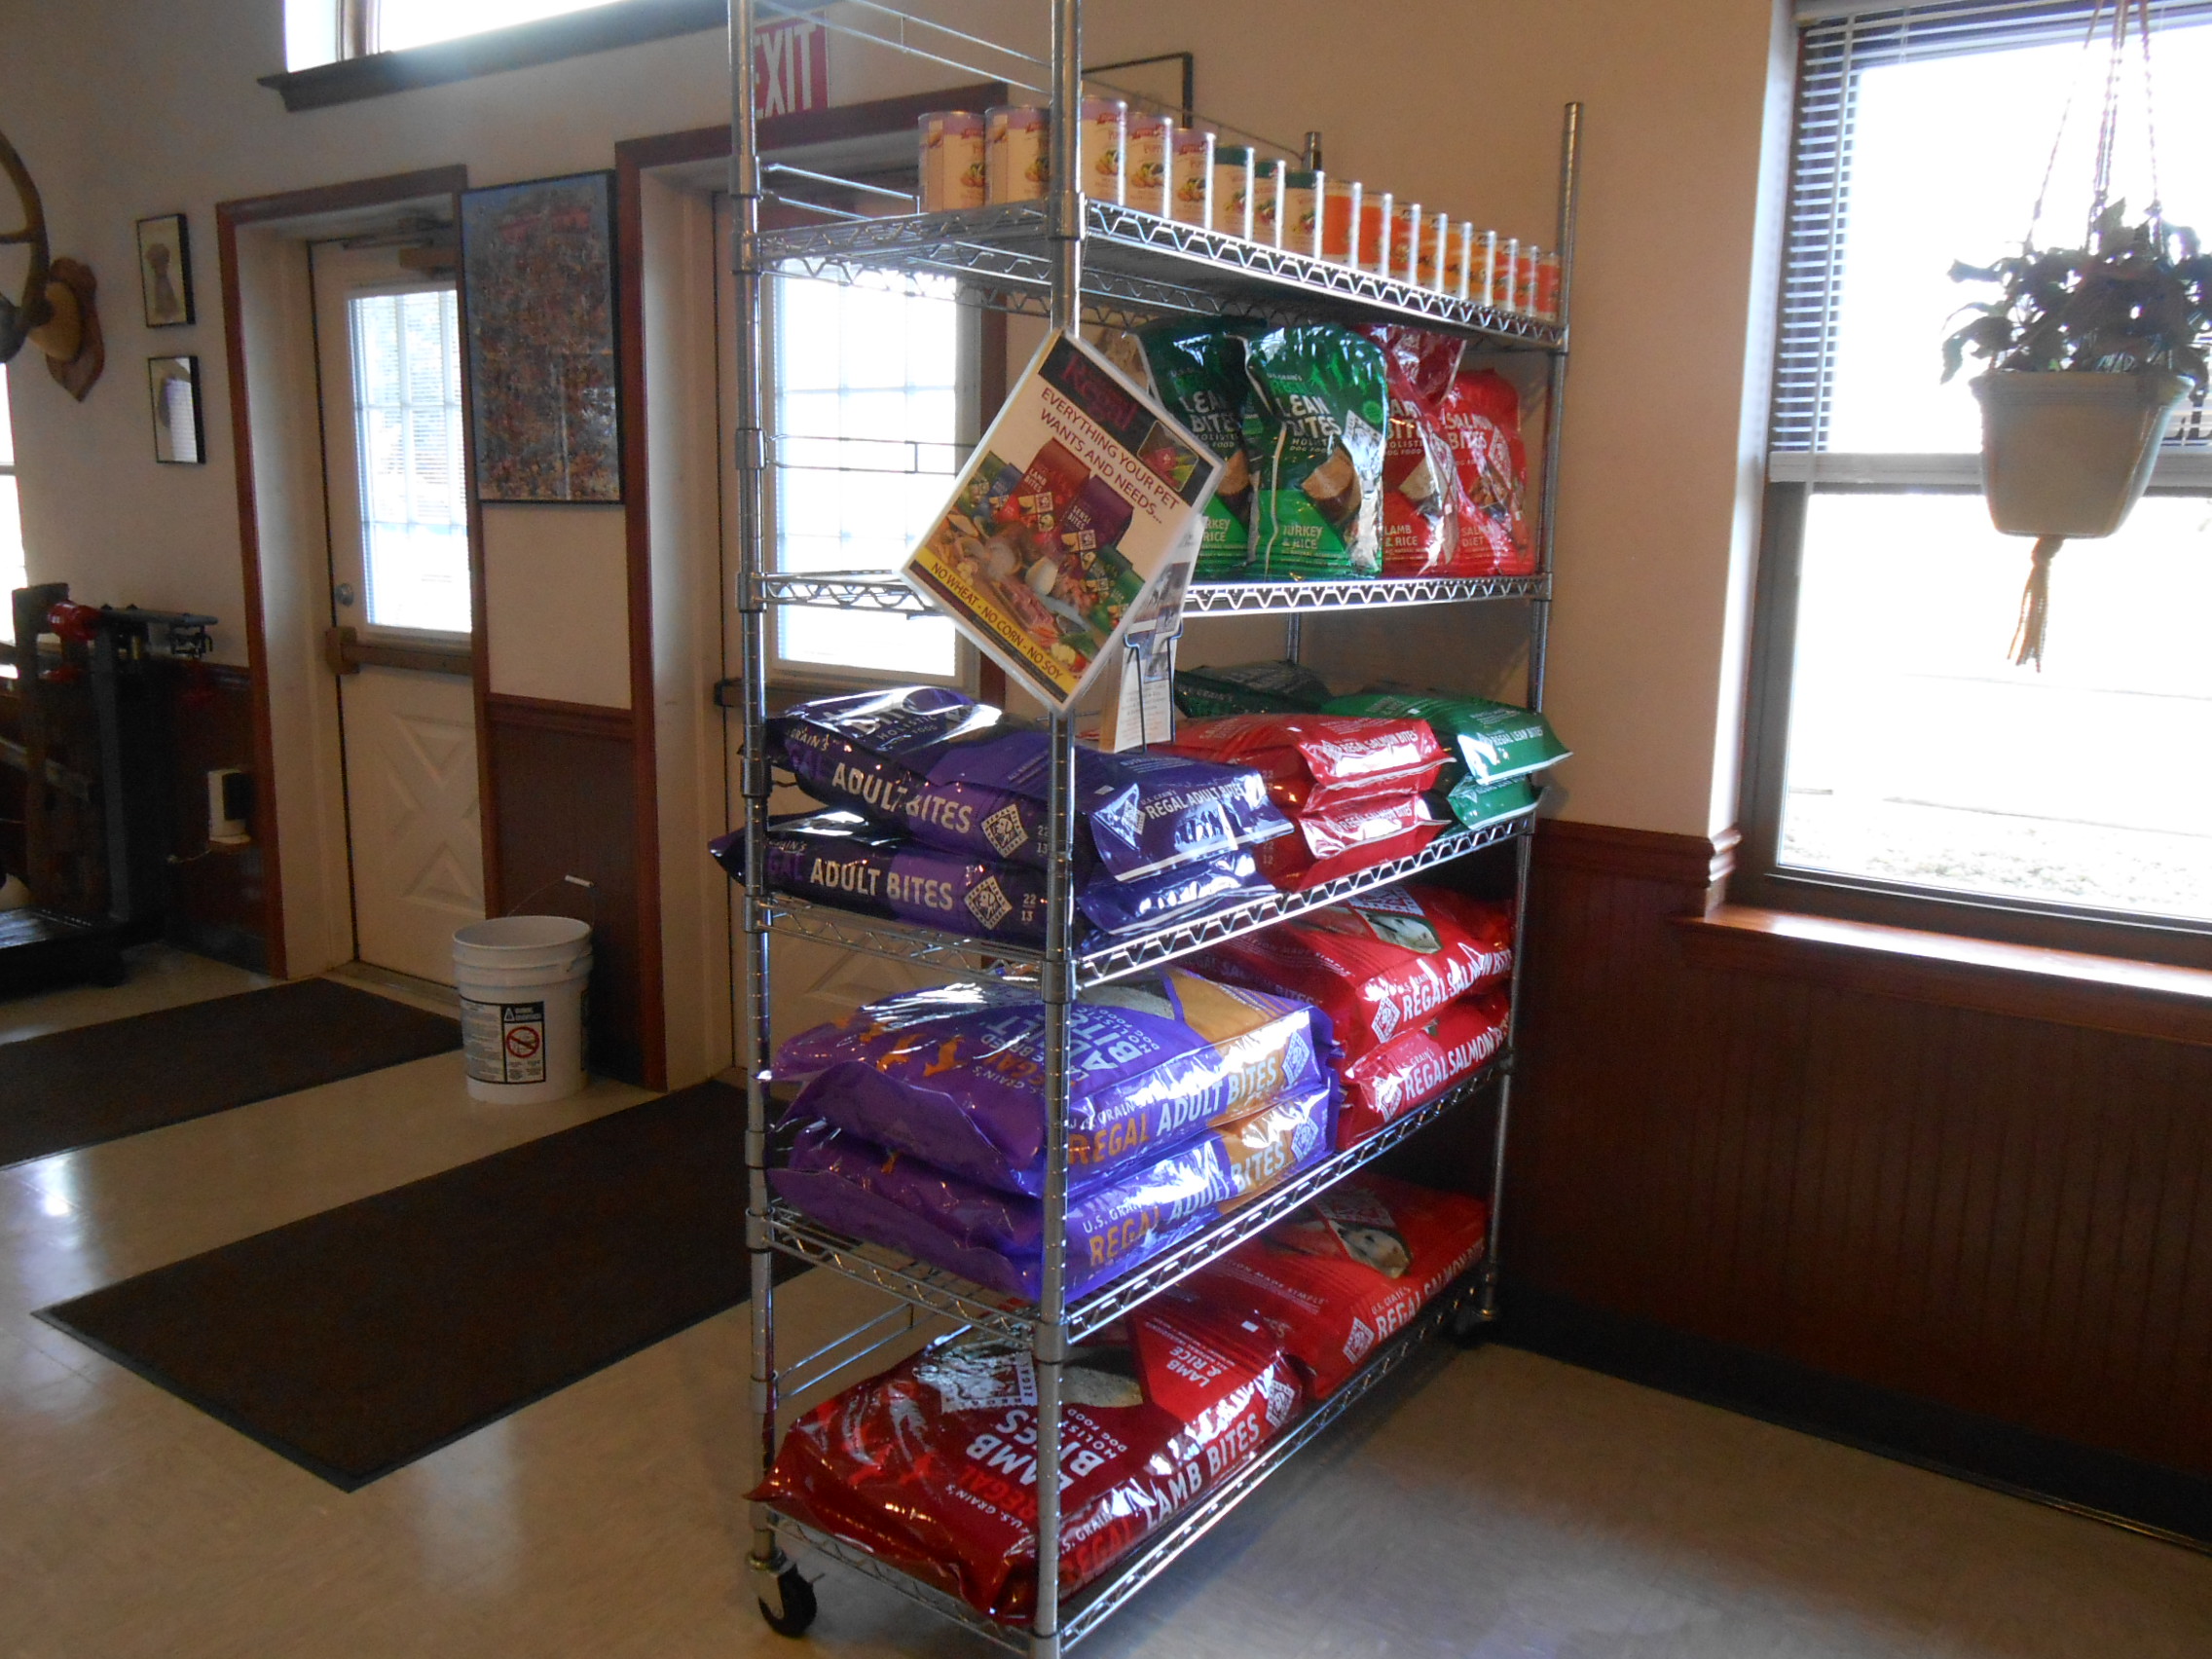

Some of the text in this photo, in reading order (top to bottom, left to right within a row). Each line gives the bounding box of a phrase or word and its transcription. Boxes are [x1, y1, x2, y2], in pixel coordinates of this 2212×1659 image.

[754, 22, 817, 119] XIT
[1178, 390, 1233, 414] LEA
[1275, 394, 1330, 417] LEAN
[1285, 416, 1342, 438] BITES
[1041, 387, 1180, 510] EVERYTHING YOUR PET
[1028, 467, 1048, 486] LAMB
[1041, 408, 1162, 524] WANTS AND NEEDS...
[1024, 475, 1043, 493] BITES
[1067, 513, 1086, 531] BITES
[1072, 505, 1091, 523] SENSI
[1203, 531, 1227, 542] RICE
[1283, 525, 1323, 538] TURKEY
[1292, 538, 1318, 549] RICE
[1384, 525, 1412, 535] LAMB
[1395, 535, 1419, 546] RICE
[1462, 536, 1485, 547] DIET
[931, 562, 947, 579] NO
[946, 574, 979, 610] WHEAT
[981, 607, 999, 623] NO
[997, 619, 1024, 648] CORN
[1026, 646, 1044, 664] NO
[1042, 660, 1063, 681] SOY
[832, 762, 973, 834] ADULT BITES
[1145, 794, 1189, 820] REGAL
[1188, 786, 1221, 808] ADULT
[1036, 843, 1049, 854] 13
[809, 858, 881, 897] ADULT
[886, 871, 954, 911] BITES
[1023, 893, 1037, 904] 22
[1021, 910, 1034, 922] 13
[1403, 977, 1449, 1022] REGAL
[1447, 953, 1493, 998] SALMN
[1076, 1007, 1153, 1055] HOLISTIC
[1098, 1009, 1161, 1051] DOG FOOD
[973, 1065, 1025, 1089] GRAIN'S
[1404, 1055, 1449, 1101] REGAL
[1447, 1031, 1495, 1076] SALMON
[1068, 1056, 1277, 1165] REGAL ADULT BITES
[1089, 1206, 1161, 1267] REGAL
[1231, 1141, 1286, 1194] BITES
[1082, 1214, 1109, 1234] U.S.
[1287, 1287, 1326, 1306] SIMPLE
[1166, 1359, 1211, 1387] LAMB
[1169, 1346, 1223, 1378] & RICE
[995, 1409, 1105, 1478] BIES
[1060, 1419, 1118, 1459] HOLIST
[1067, 1408, 1128, 1453] DOG FOOD
[1143, 1461, 1202, 1530] LAMB
[1206, 1413, 1260, 1477] BITES
[944, 1483, 997, 1515] GRAIN'S
[1075, 1507, 1115, 1541] GRAIN
